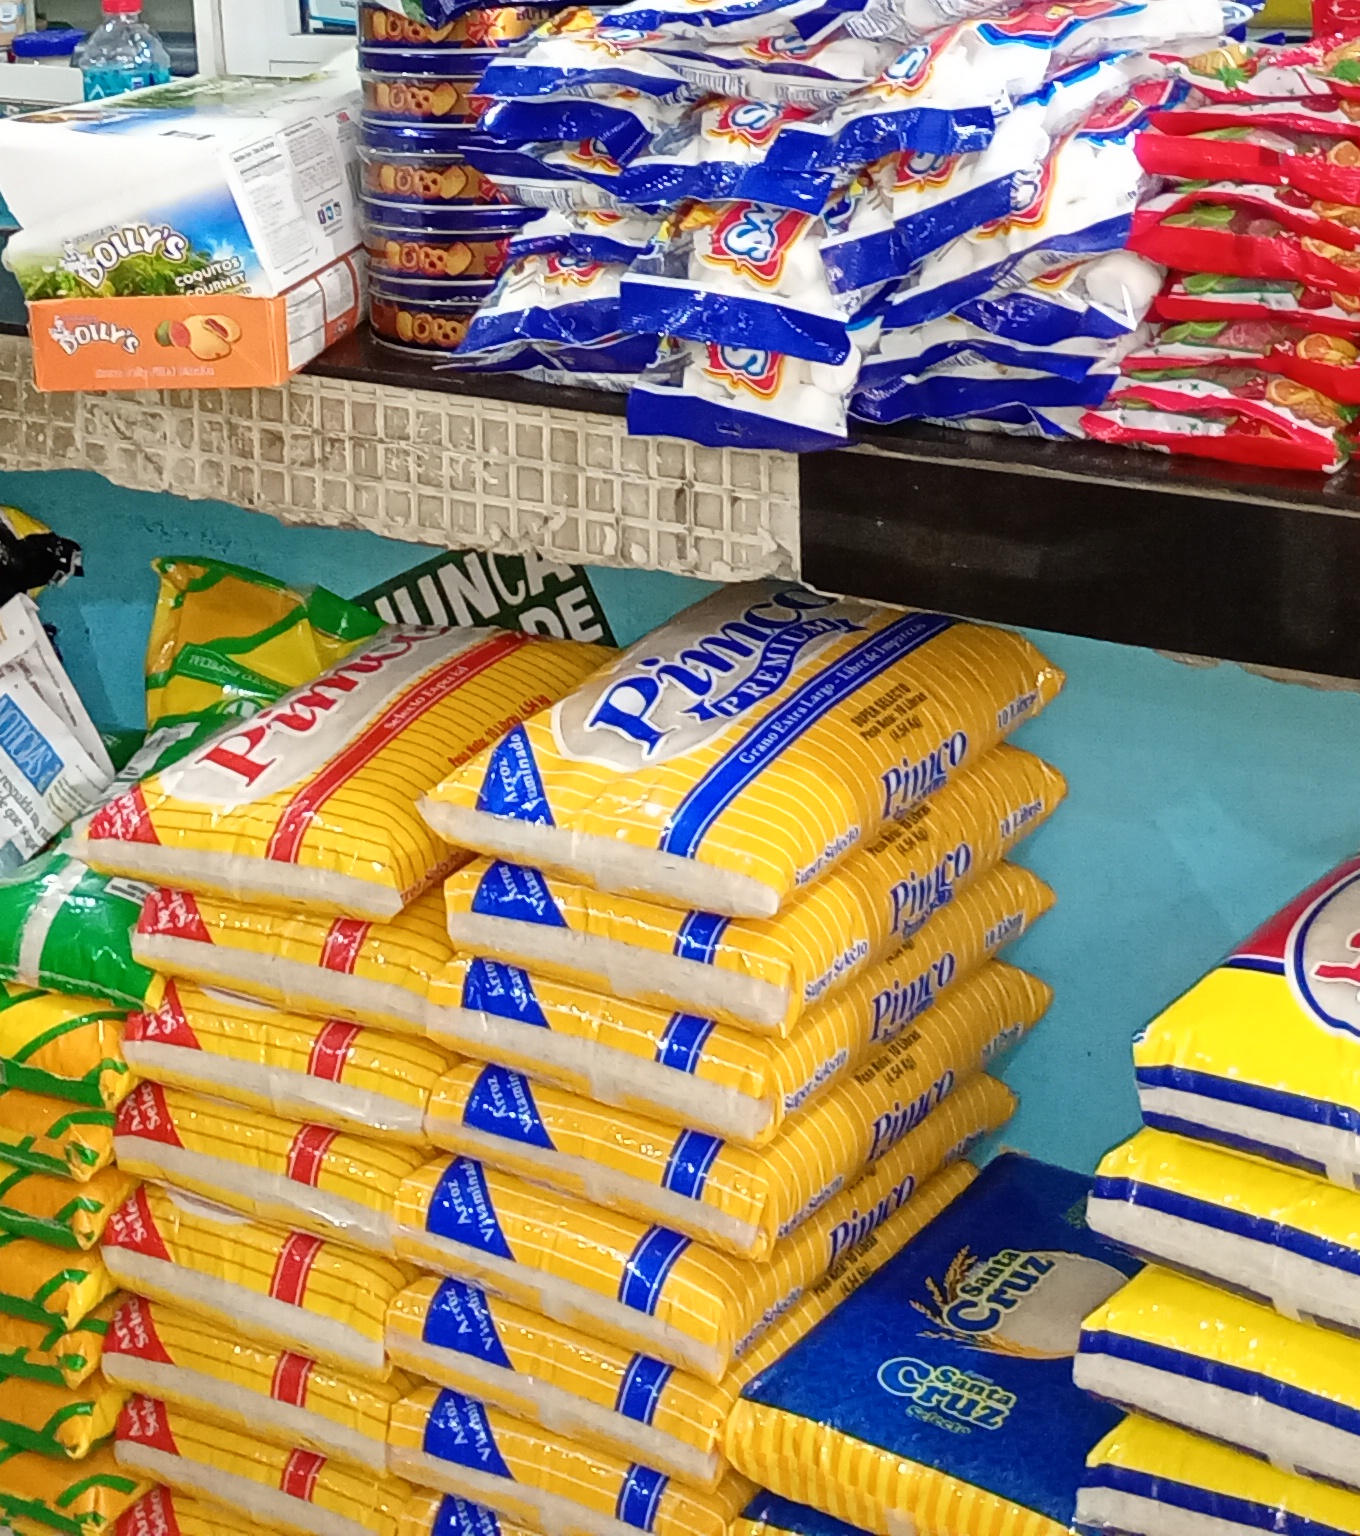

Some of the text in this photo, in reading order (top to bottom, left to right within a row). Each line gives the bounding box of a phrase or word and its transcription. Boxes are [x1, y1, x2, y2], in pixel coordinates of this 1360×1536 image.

[77, 224, 188, 290] DOLLY'S
[174, 255, 242, 288] COQUITOS
[57, 321, 140, 356] DOLLY'S
[590, 587, 840, 757] Pimco
[715, 617, 834, 717] PREMIUM
[738, 732, 779, 765] Grano
[770, 705, 809, 735] Extra
[799, 682, 835, 708] Largo
[864, 650, 881, 663] de
[881, 730, 969, 821] Pimco
[889, 842, 973, 935] Pimco
[870, 952, 956, 1043] Pimco
[866, 1068, 955, 1164] Pimco
[448, 1179, 470, 1226] Arroz
[944, 1253, 1056, 1335] Cruz
[959, 1247, 1021, 1301] Santa
[877, 1356, 1010, 1429] Cruz
[930, 1366, 1018, 1409] Santa
